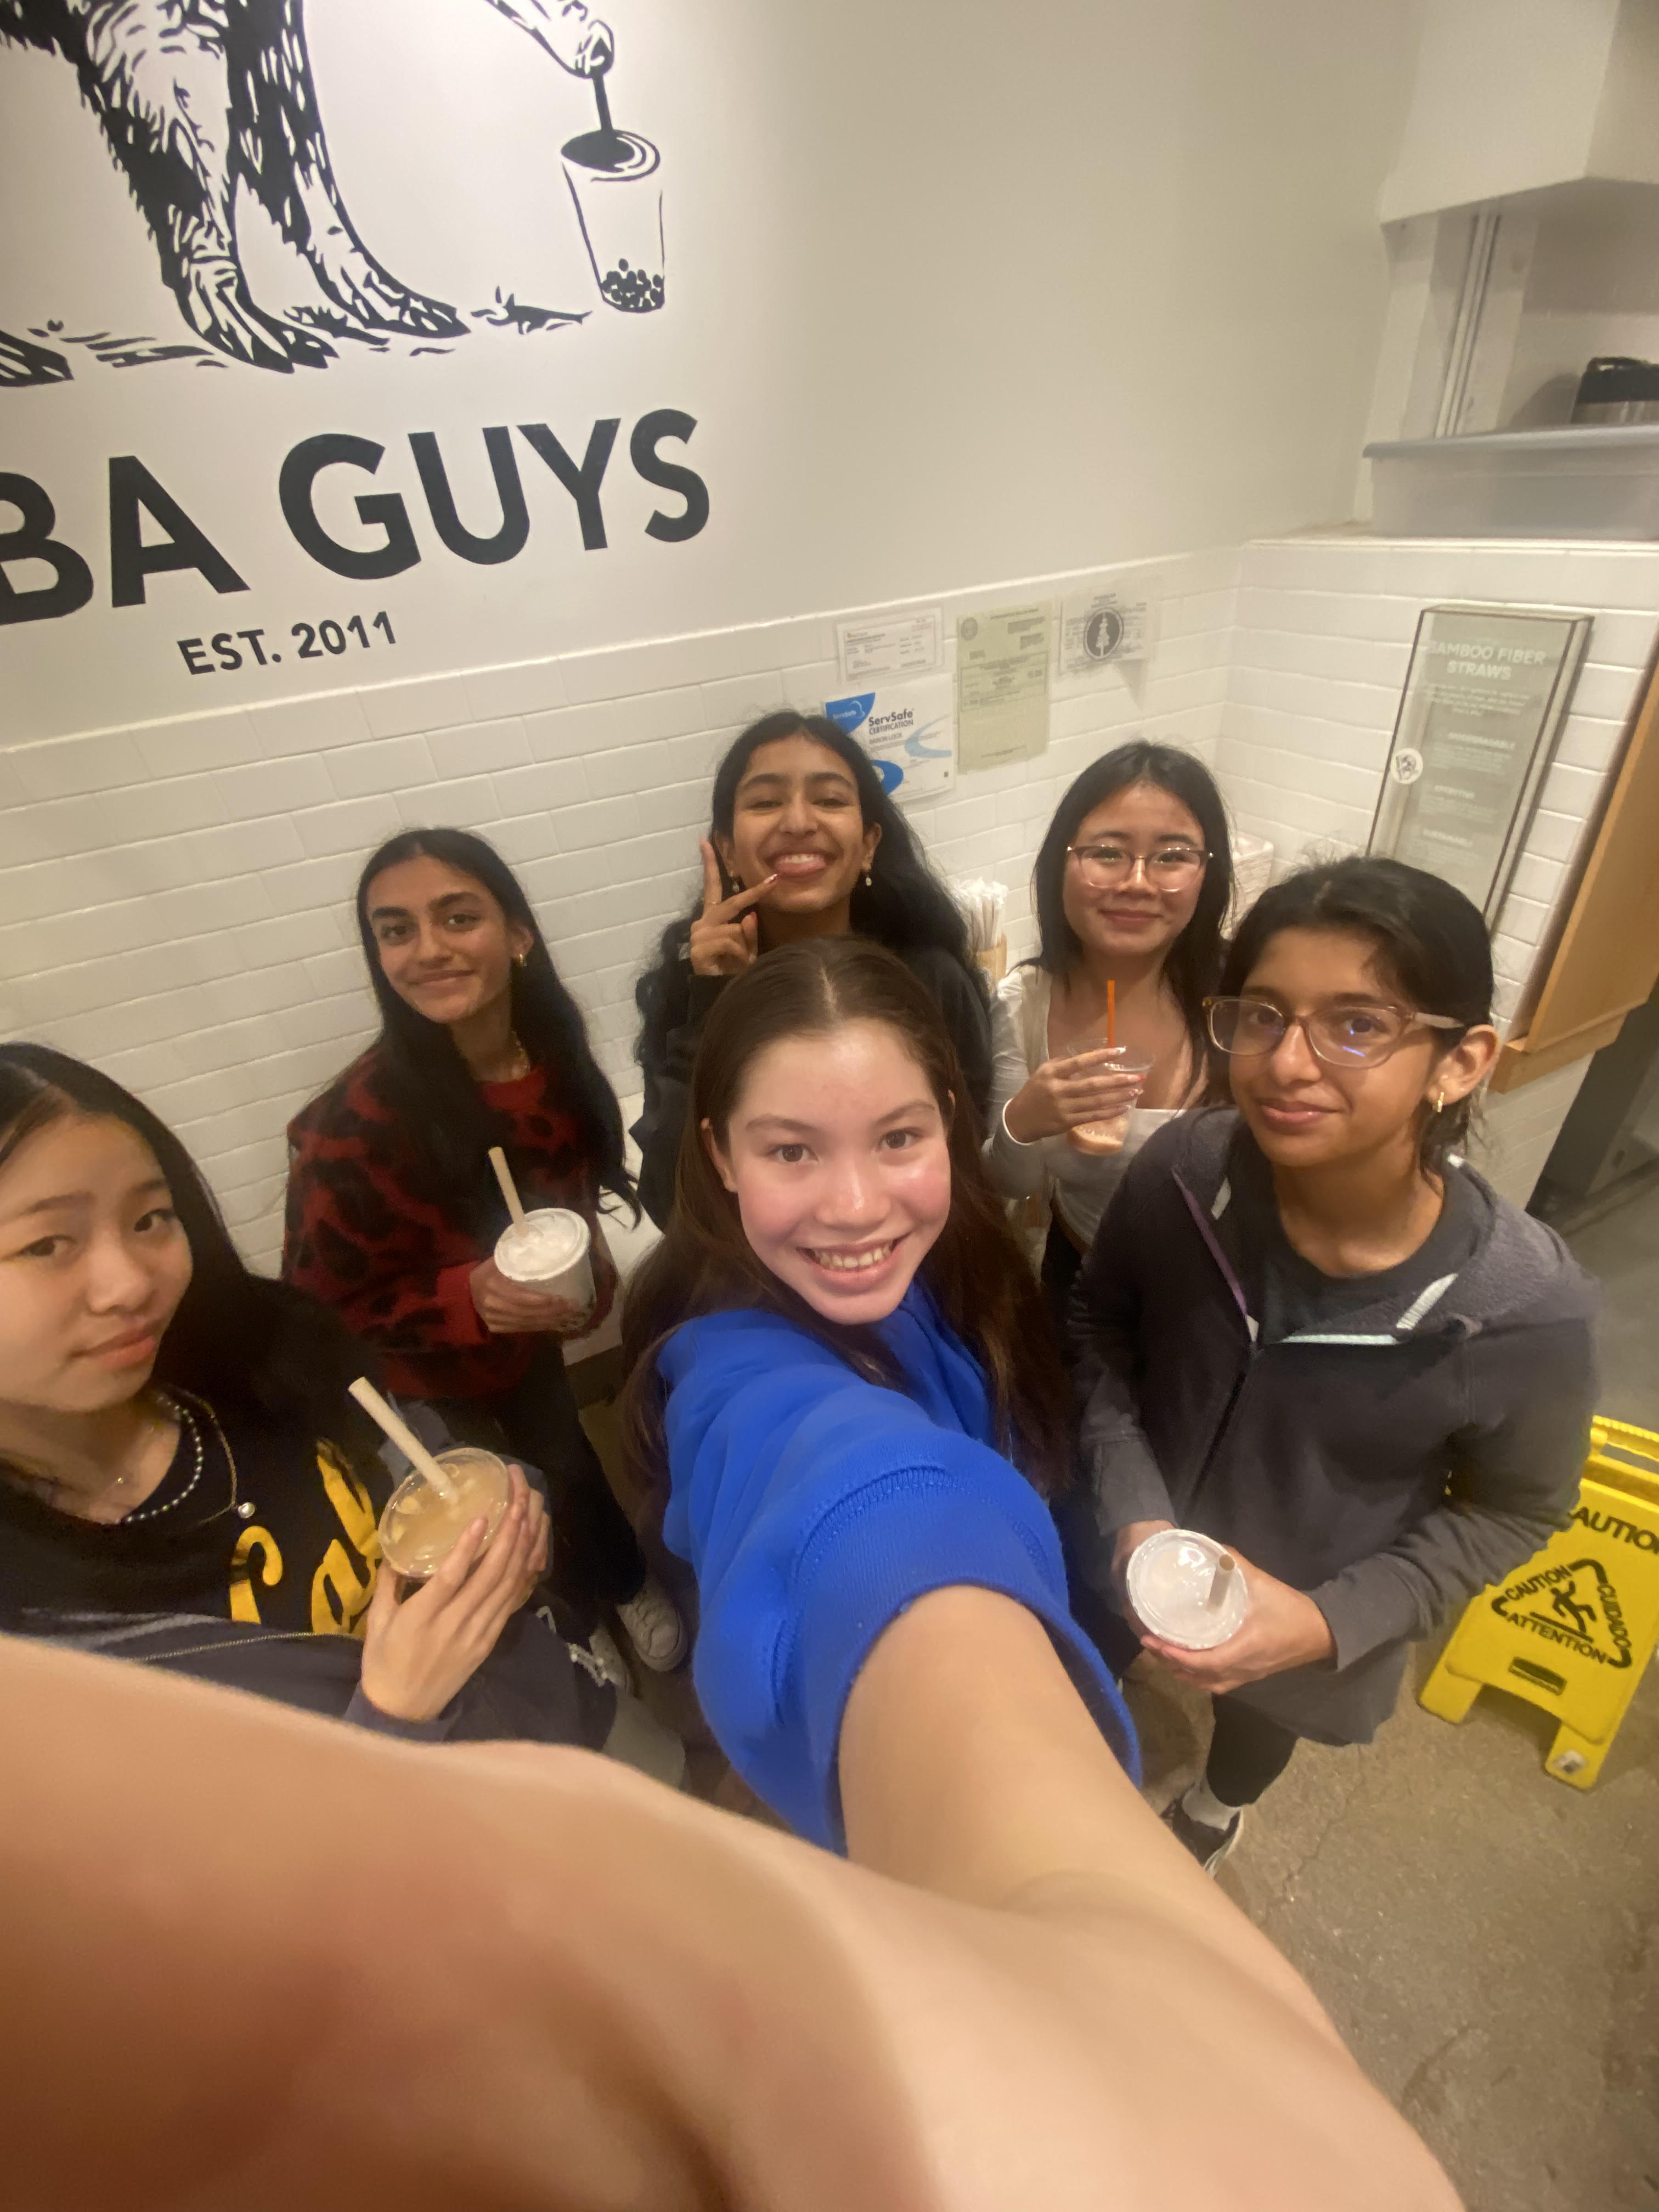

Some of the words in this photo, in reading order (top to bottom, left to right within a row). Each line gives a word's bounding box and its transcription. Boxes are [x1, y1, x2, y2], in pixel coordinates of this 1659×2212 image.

[278, 408, 710, 581] GUYS
[177, 629, 282, 675] EST.
[291, 611, 396, 658] 2011
[1497, 647, 1547, 665] FIBER
[1447, 660, 1513, 680] STRAWS
[868, 708, 913, 726] ServSafe
[869, 719, 914, 735] CERTIFICATION
[1505, 1564, 1572, 1601] CAUTION
[1506, 1612, 1608, 1664] ATTENTION
